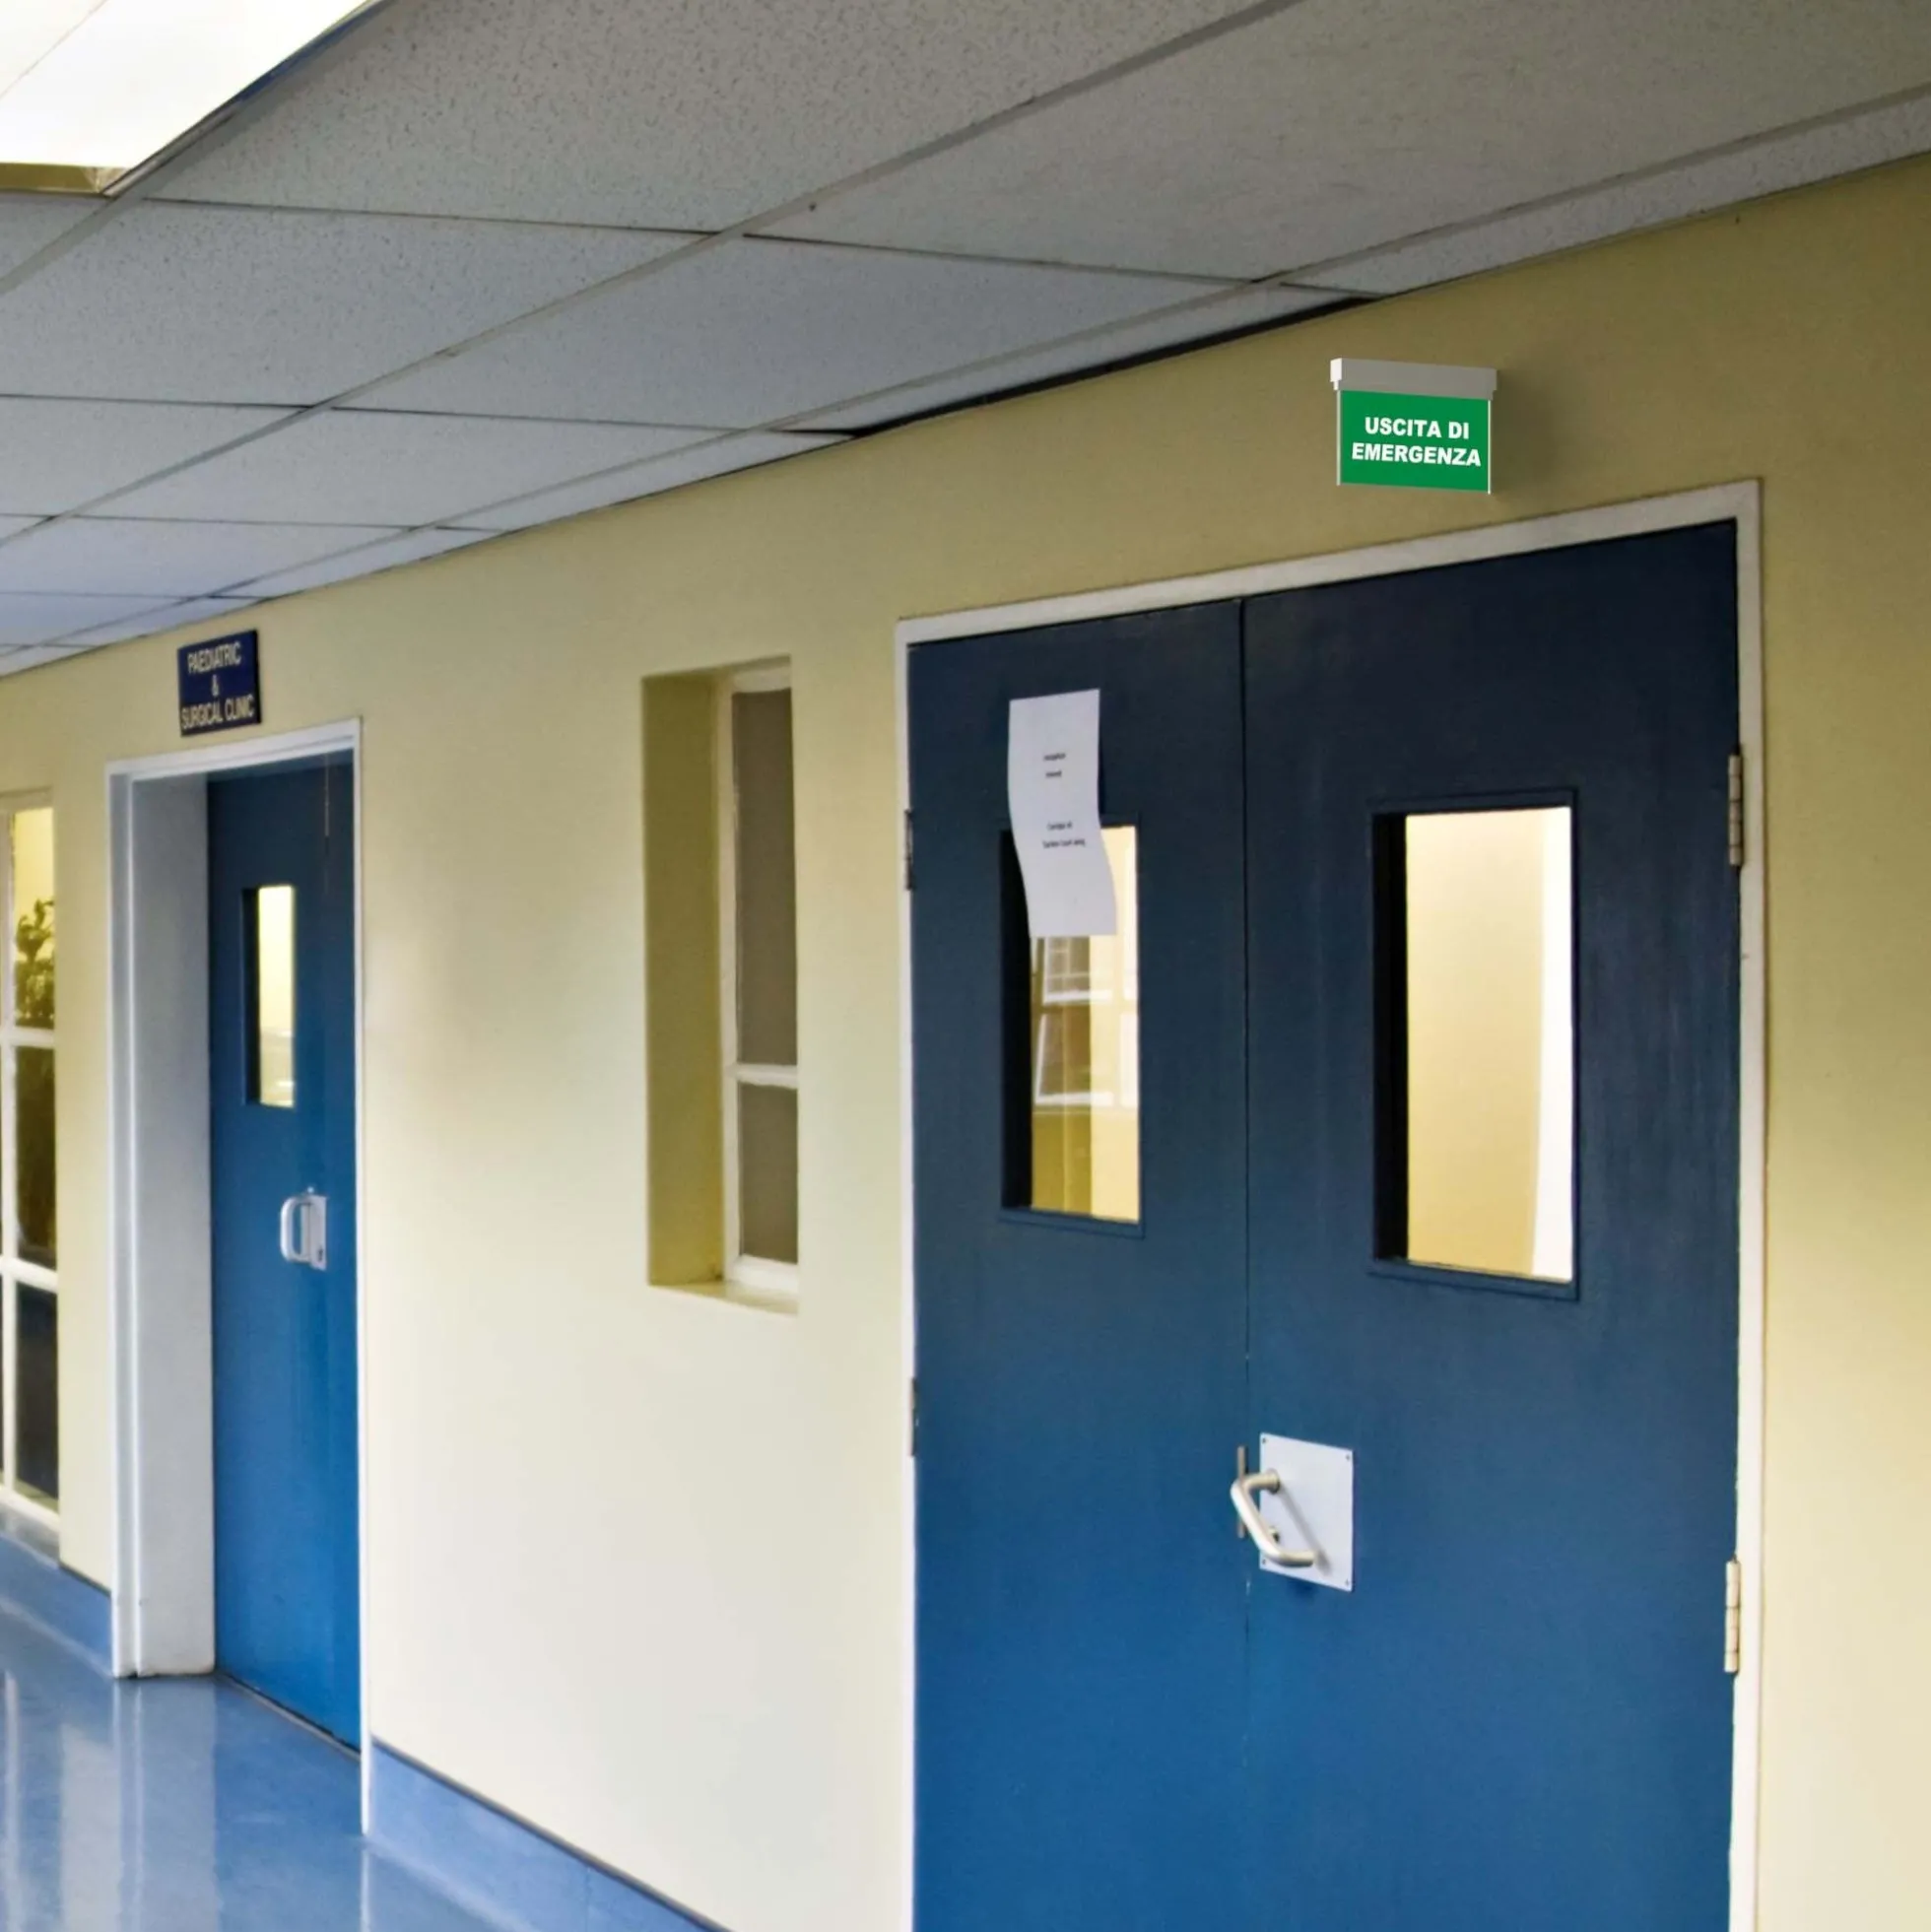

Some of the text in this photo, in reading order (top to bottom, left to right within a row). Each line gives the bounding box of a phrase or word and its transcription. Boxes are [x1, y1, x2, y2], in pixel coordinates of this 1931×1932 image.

[1365, 417, 1469, 439] USCITA DI
[1352, 442, 1481, 467] EMERGENZA
[187, 641, 241, 674] PAEDIATRIC
[181, 694, 254, 729] SURGICAL CLINIC
